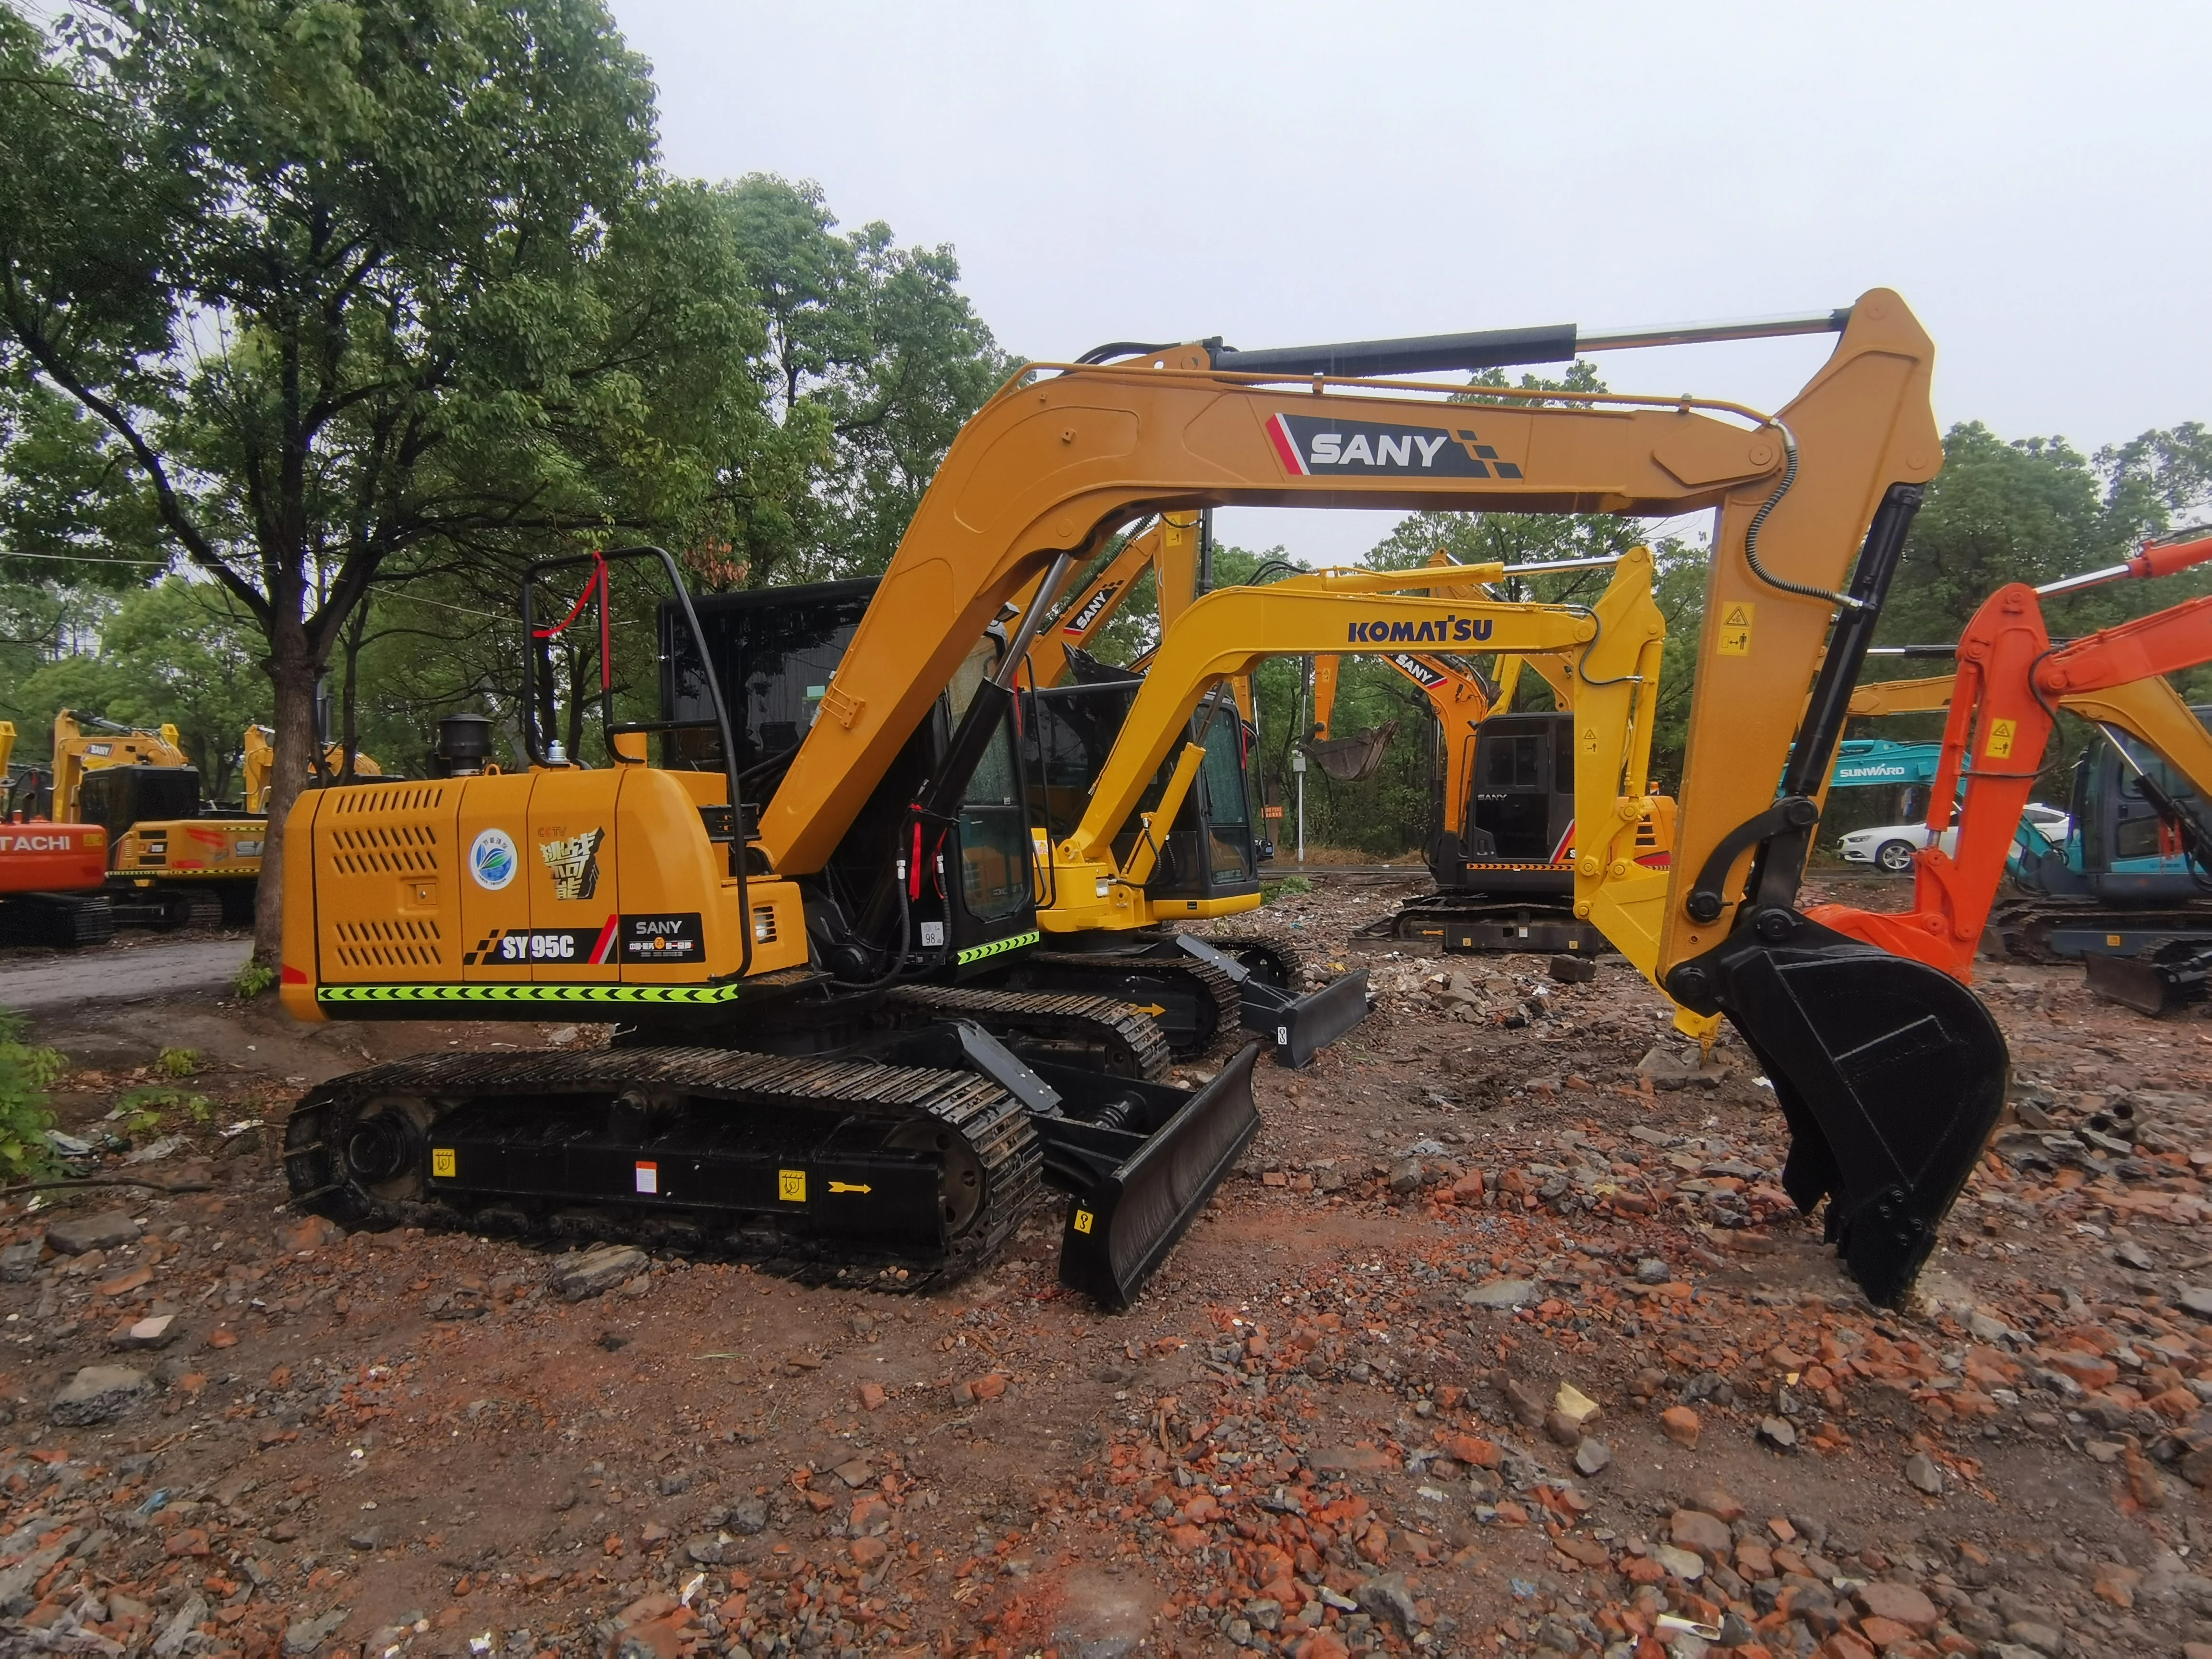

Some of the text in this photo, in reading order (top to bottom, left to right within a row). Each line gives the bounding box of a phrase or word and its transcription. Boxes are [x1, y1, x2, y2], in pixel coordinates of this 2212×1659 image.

[1310, 434, 1448, 467] SANY
[1076, 591, 1106, 629] SANY
[1348, 615, 1492, 643] KOMATSU
[1395, 654, 1433, 682] SANY
[90, 745, 110, 756] SANY
[1840, 763, 1905, 777] SUNWARD
[0, 836, 70, 851] TACHI
[538, 827, 567, 837] CCTV
[539, 827, 599, 863] 挑战
[544, 854, 590, 879] 不可
[553, 877, 583, 900] 能
[636, 921, 683, 934] SANY
[926, 933, 936, 944] 98
